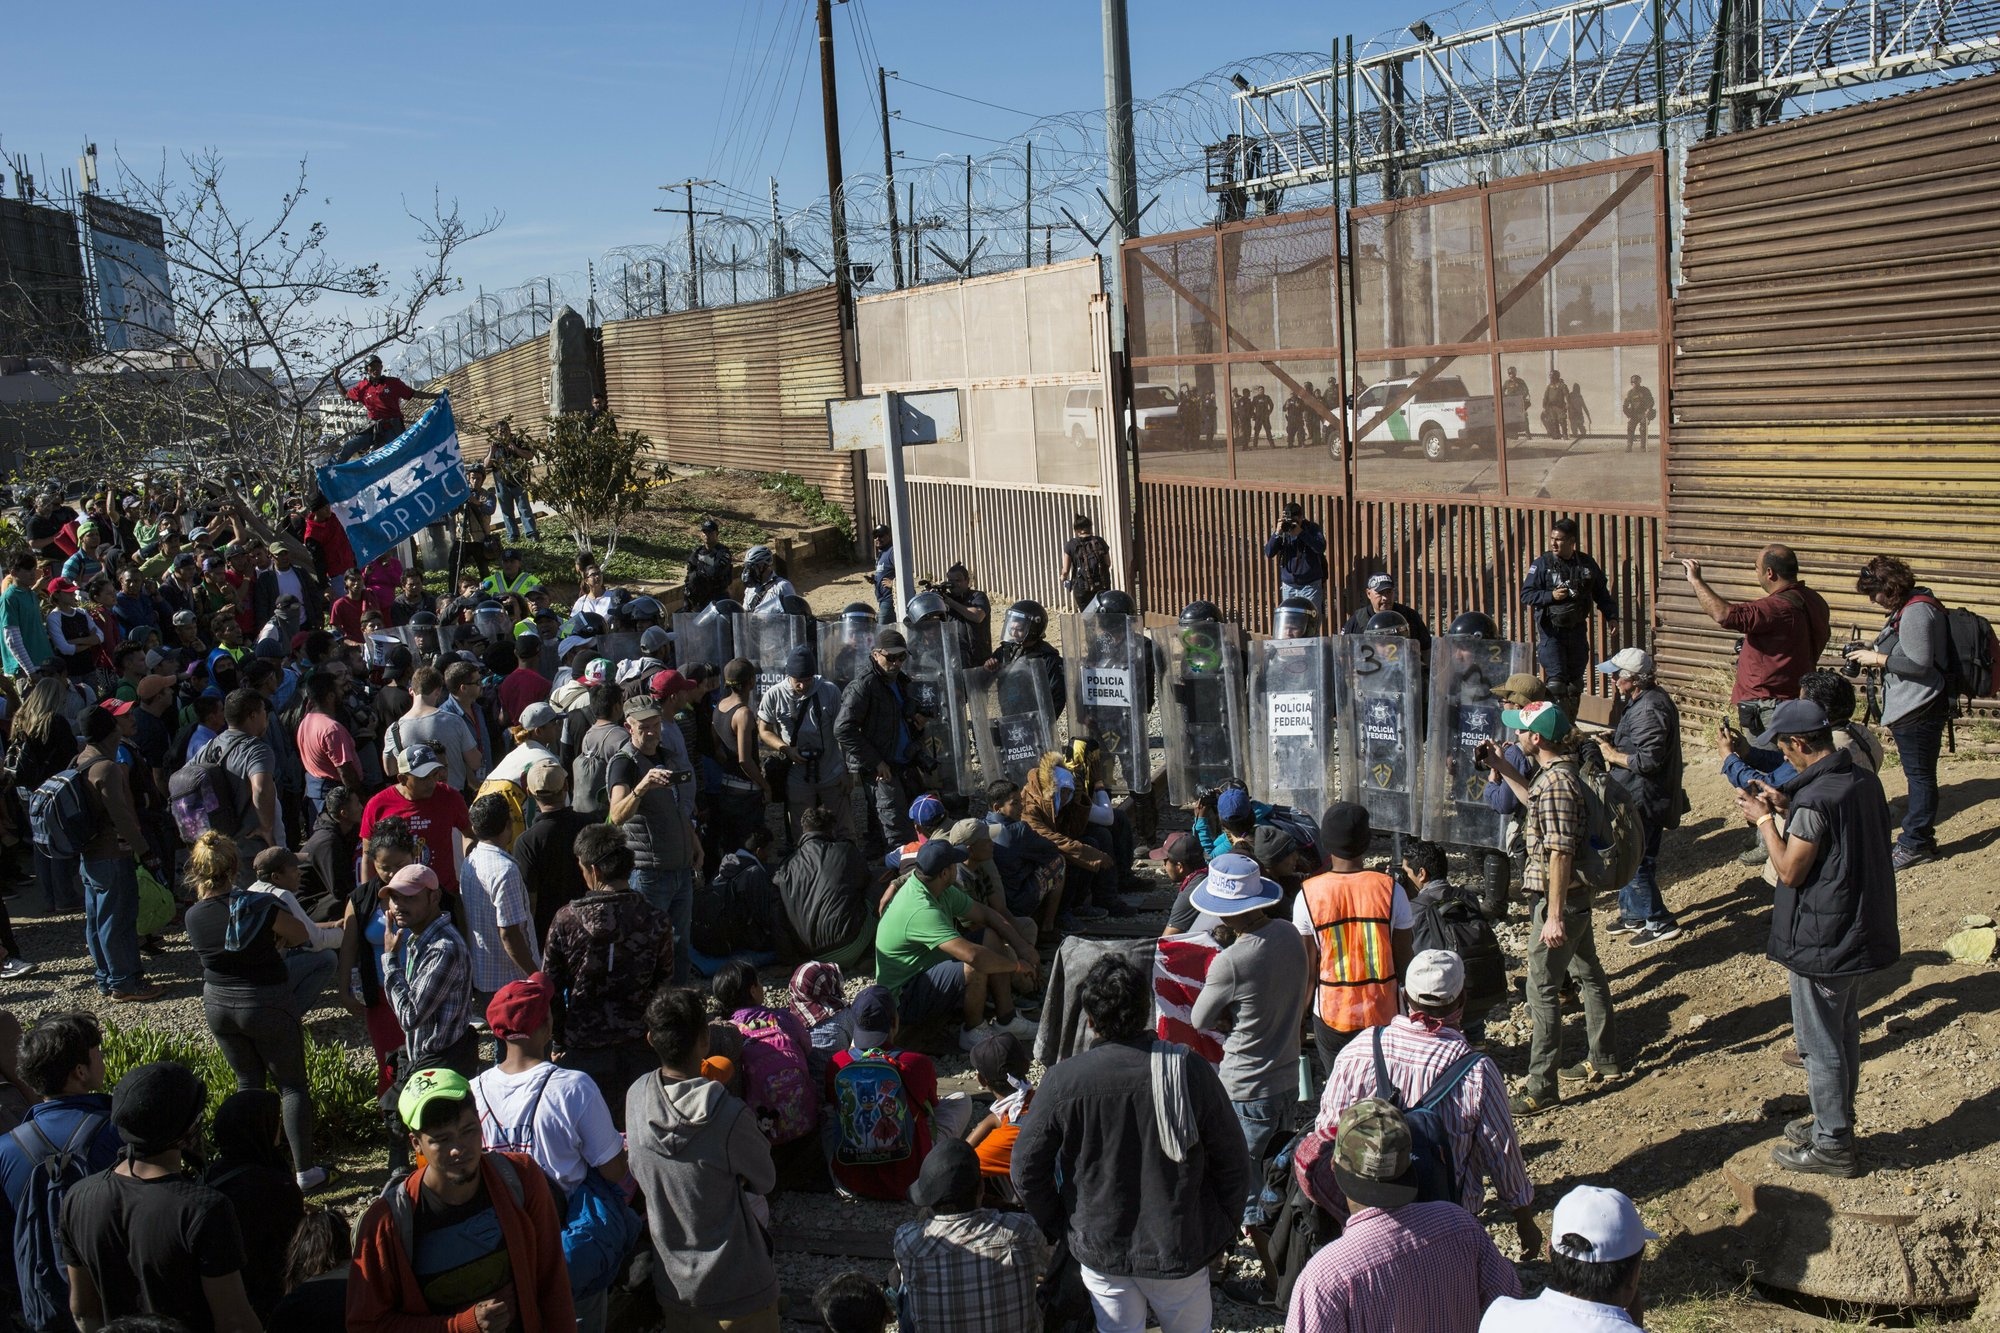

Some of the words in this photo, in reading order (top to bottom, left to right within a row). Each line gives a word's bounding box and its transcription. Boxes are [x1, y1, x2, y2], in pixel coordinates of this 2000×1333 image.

[1386, 643, 1399, 661] 2
[1488, 645, 1502, 663] 2
[1357, 644, 1382, 676] 3
[1087, 676, 1124, 685] POLICIA
[1088, 688, 1124, 697] FEDERAL
[1274, 703, 1312, 713] POLICIA
[1274, 716, 1312, 726] FEDERAL
[1367, 731, 1397, 740] FEDERAL
[1461, 738, 1482, 747] FEDER
[1008, 751, 1036, 761] FEDERAL
